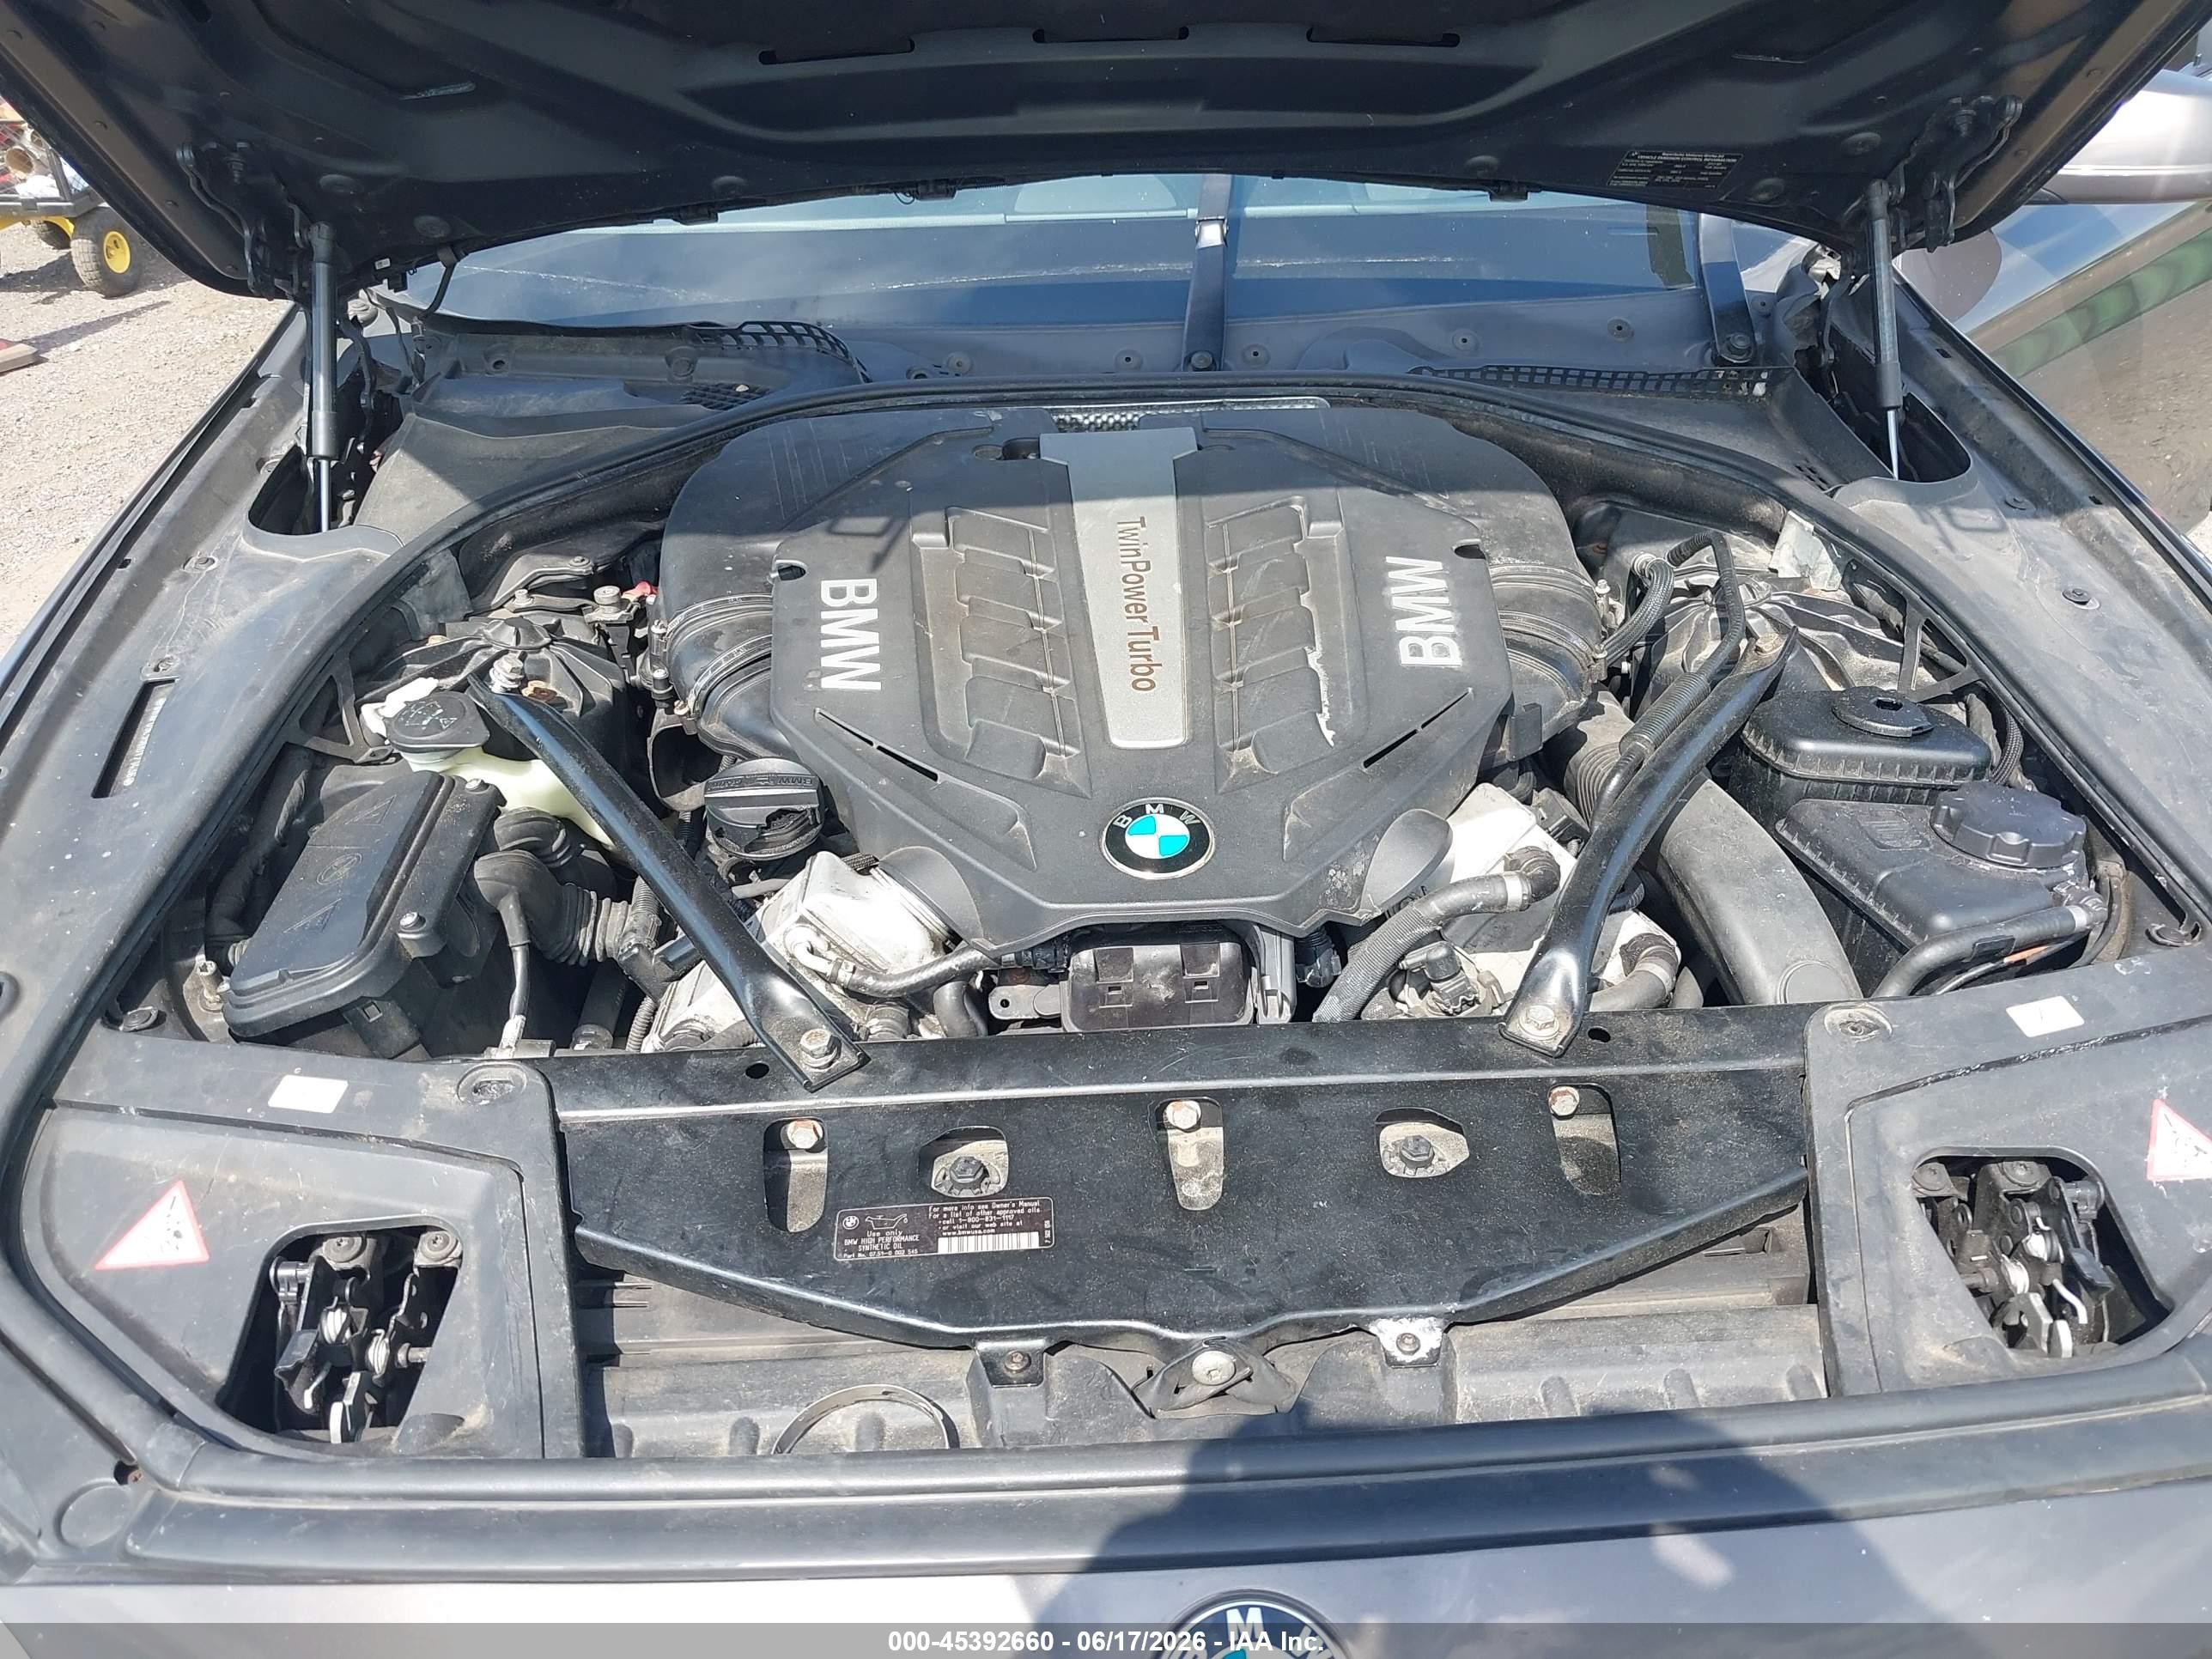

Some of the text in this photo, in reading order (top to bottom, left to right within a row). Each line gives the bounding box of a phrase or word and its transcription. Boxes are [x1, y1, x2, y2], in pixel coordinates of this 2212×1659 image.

[1116, 516, 1163, 691] TwinPower Turbo
[1385, 556, 1462, 667] BMW
[820, 578, 882, 690] BMW
[1112, 803, 1202, 829] BMW
[996, 1207, 1024, 1216] approved
[860, 1237, 876, 1245] HIGH
[878, 1234, 921, 1243] PERFORMANCE
[885, 1229, 903, 1237] only
[859, 1243, 891, 1252] SYNTHETIC
